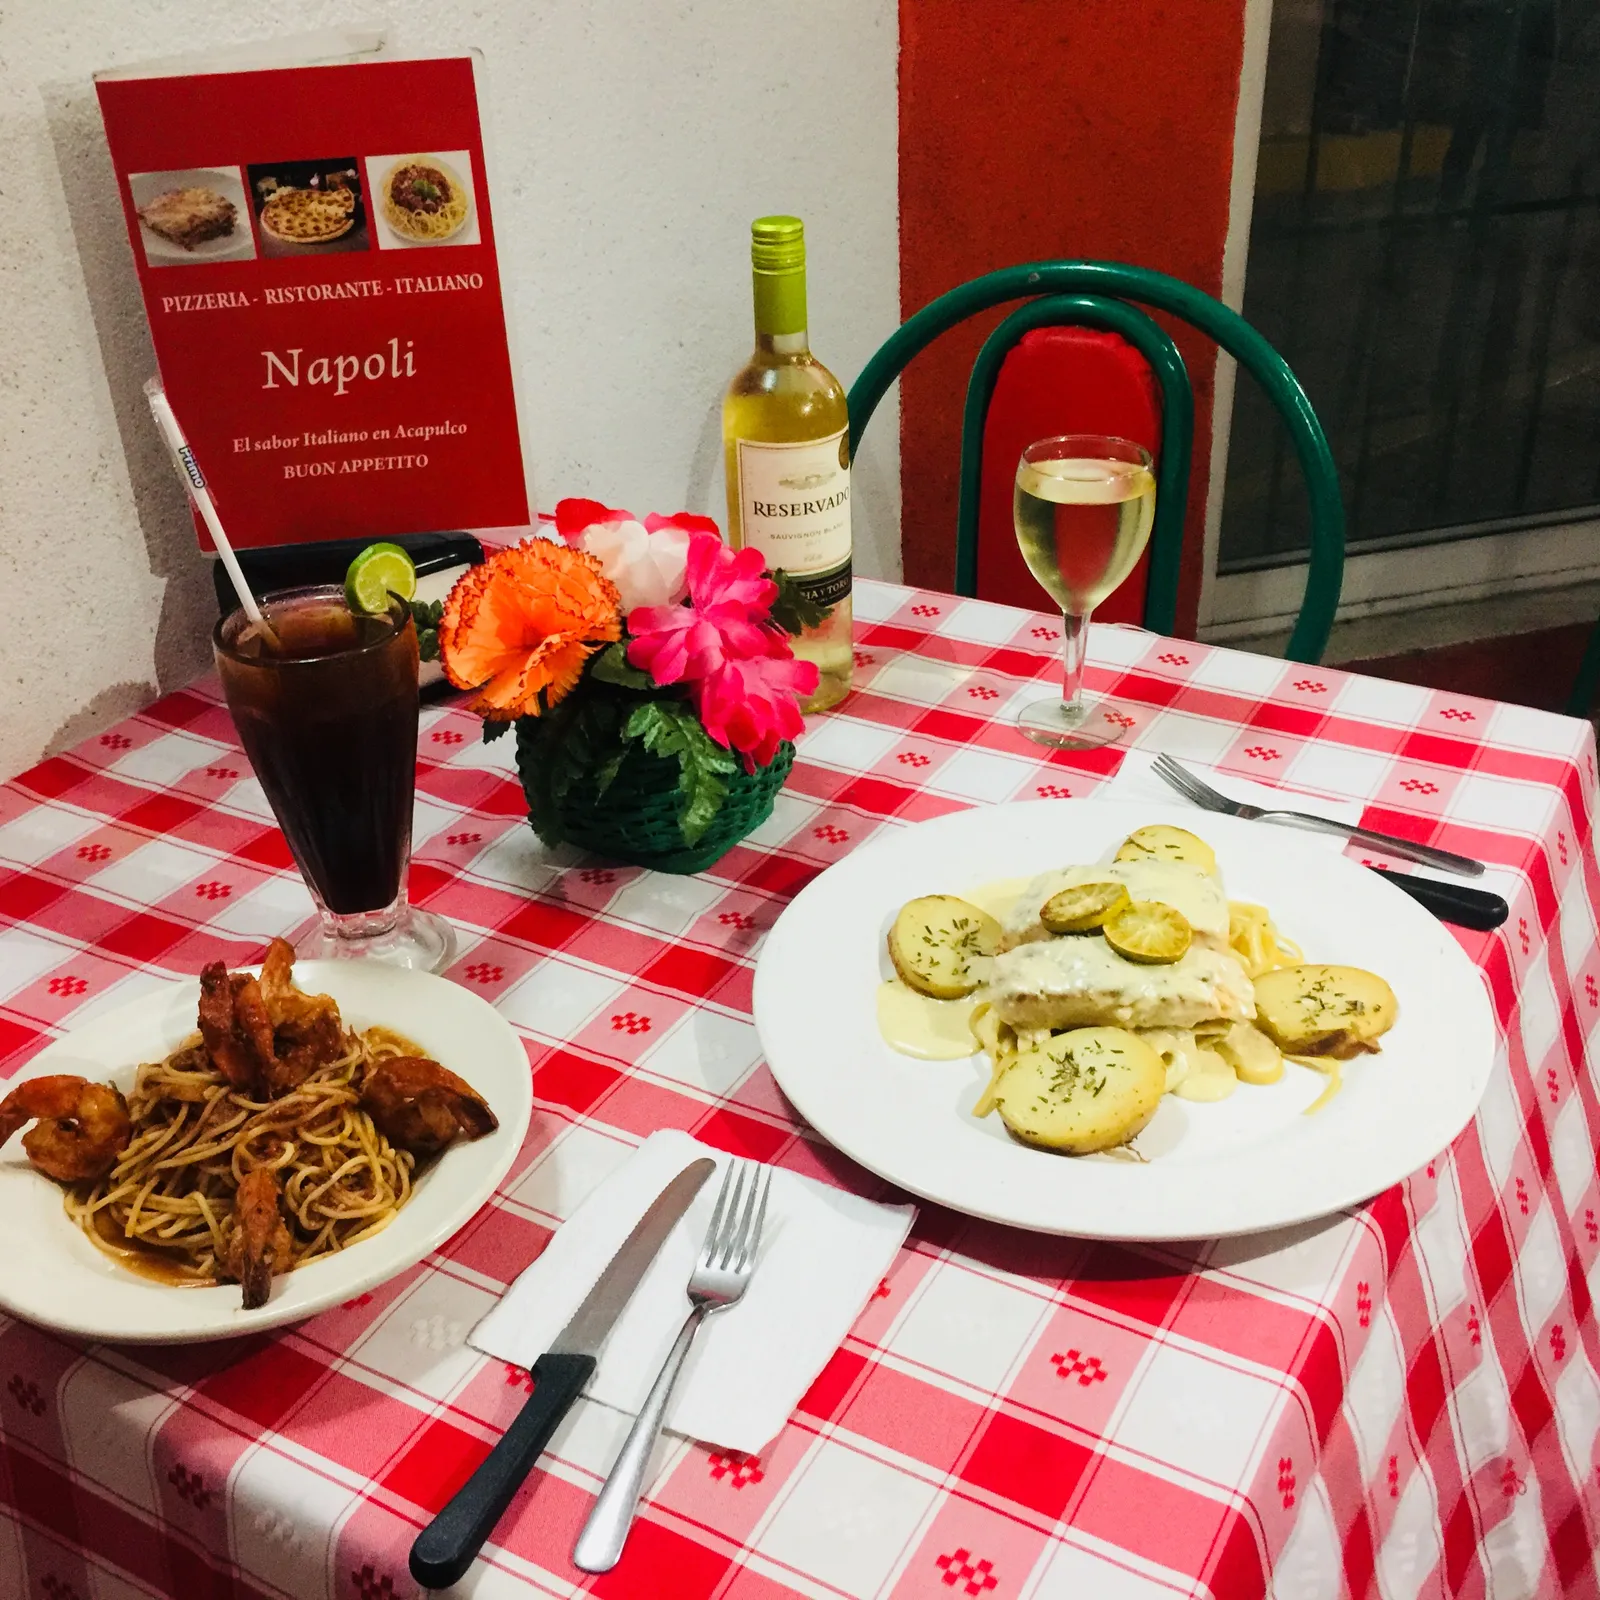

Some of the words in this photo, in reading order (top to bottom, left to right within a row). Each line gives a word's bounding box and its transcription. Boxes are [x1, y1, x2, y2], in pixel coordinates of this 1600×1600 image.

[162, 291, 250, 313] PIZZERIA
[264, 280, 384, 305] RISTORANTE
[395, 273, 484, 294] ITALIANO
[261, 338, 417, 396] Napoli
[233, 437, 250, 453] El
[254, 434, 300, 452] sabor
[303, 430, 369, 447] Italiano
[372, 430, 390, 441] en
[394, 420, 468, 441] Acapulco
[283, 462, 336, 479] BUON
[339, 454, 429, 474] APPETITO
[753, 486, 850, 518] RESERVADO
[770, 529, 821, 540] SAUVIGNON
[827, 577, 849, 594] TORO
